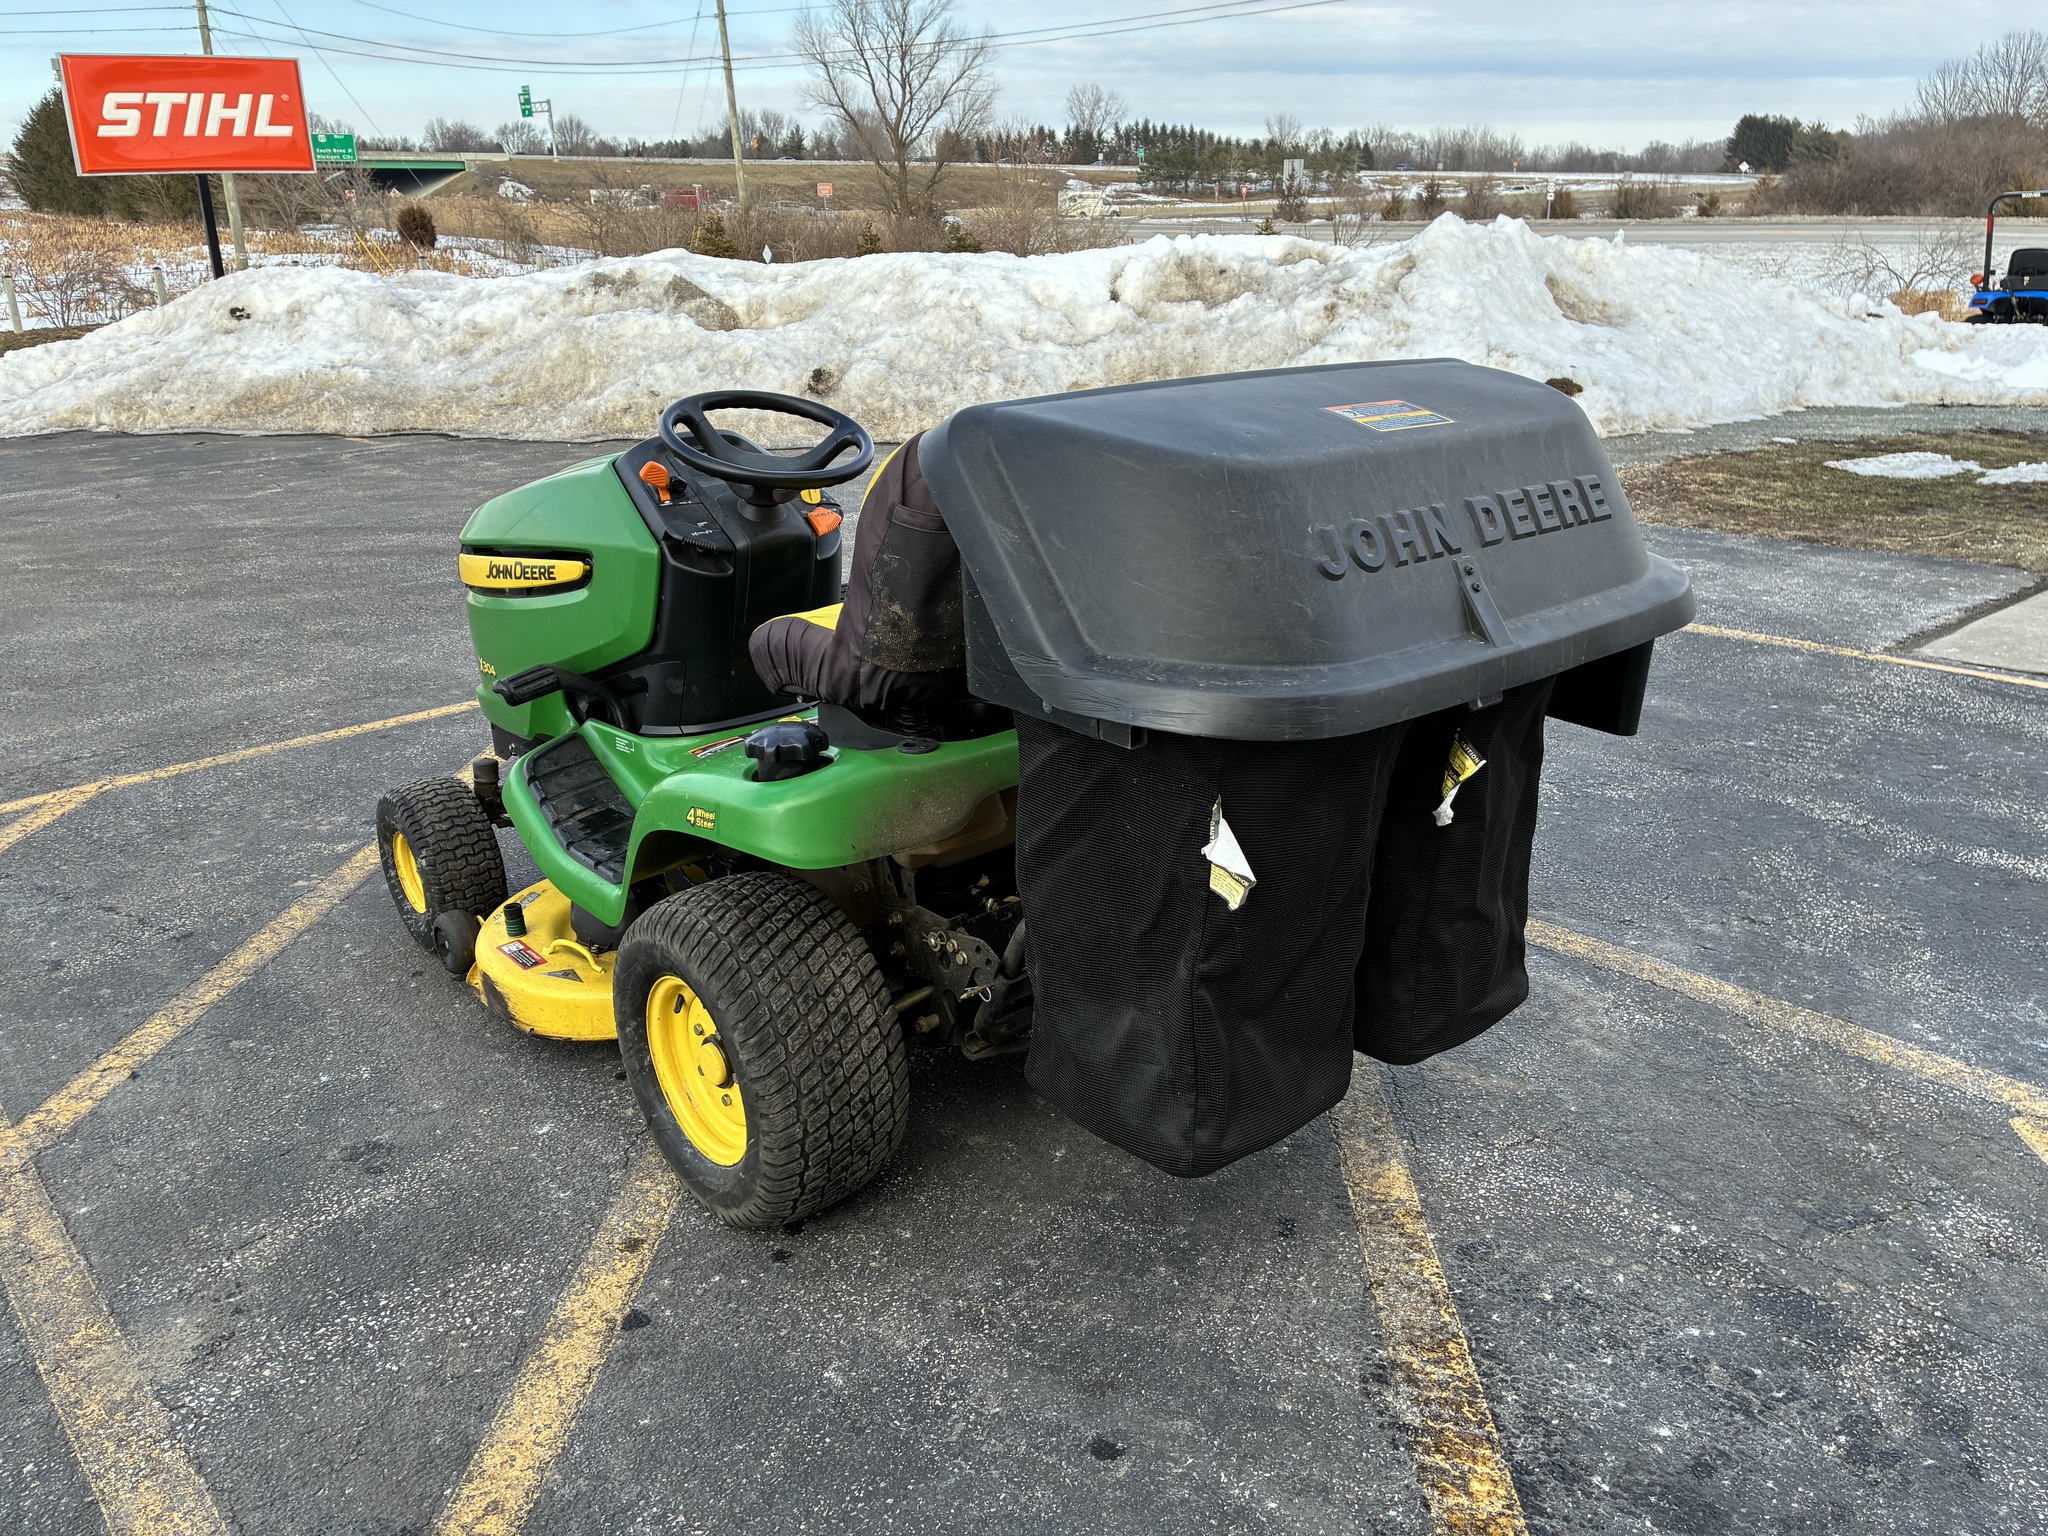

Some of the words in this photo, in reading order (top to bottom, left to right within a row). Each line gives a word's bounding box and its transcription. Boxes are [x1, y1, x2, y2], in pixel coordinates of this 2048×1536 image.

[97, 92, 293, 136] STIHL
[1313, 502, 1462, 582] JOHN
[1464, 473, 1612, 548] DEERE
[486, 560, 513, 580] JOHN
[514, 561, 557, 581] DEERE
[1460, 740, 1481, 764] CAUTION
[686, 807, 696, 825] 4
[696, 808, 716, 821] Wheel
[695, 817, 715, 830] Steer
